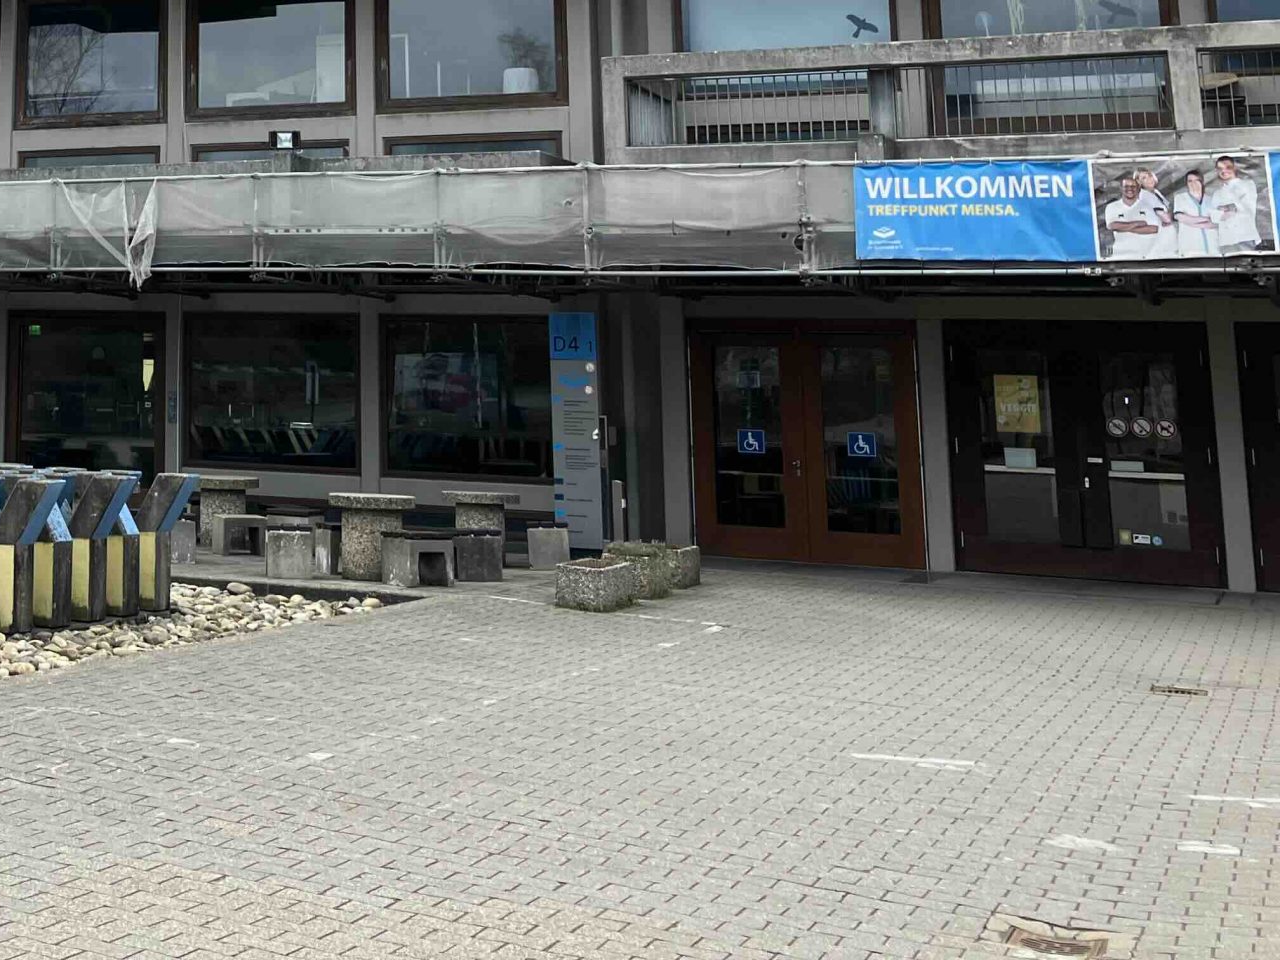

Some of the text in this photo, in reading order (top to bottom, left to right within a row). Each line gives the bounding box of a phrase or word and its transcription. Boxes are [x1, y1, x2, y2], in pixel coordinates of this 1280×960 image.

[864, 174, 1073, 199] WILLKOMMEN
[867, 203, 1020, 217] TREFFPUNKT MENSA.
